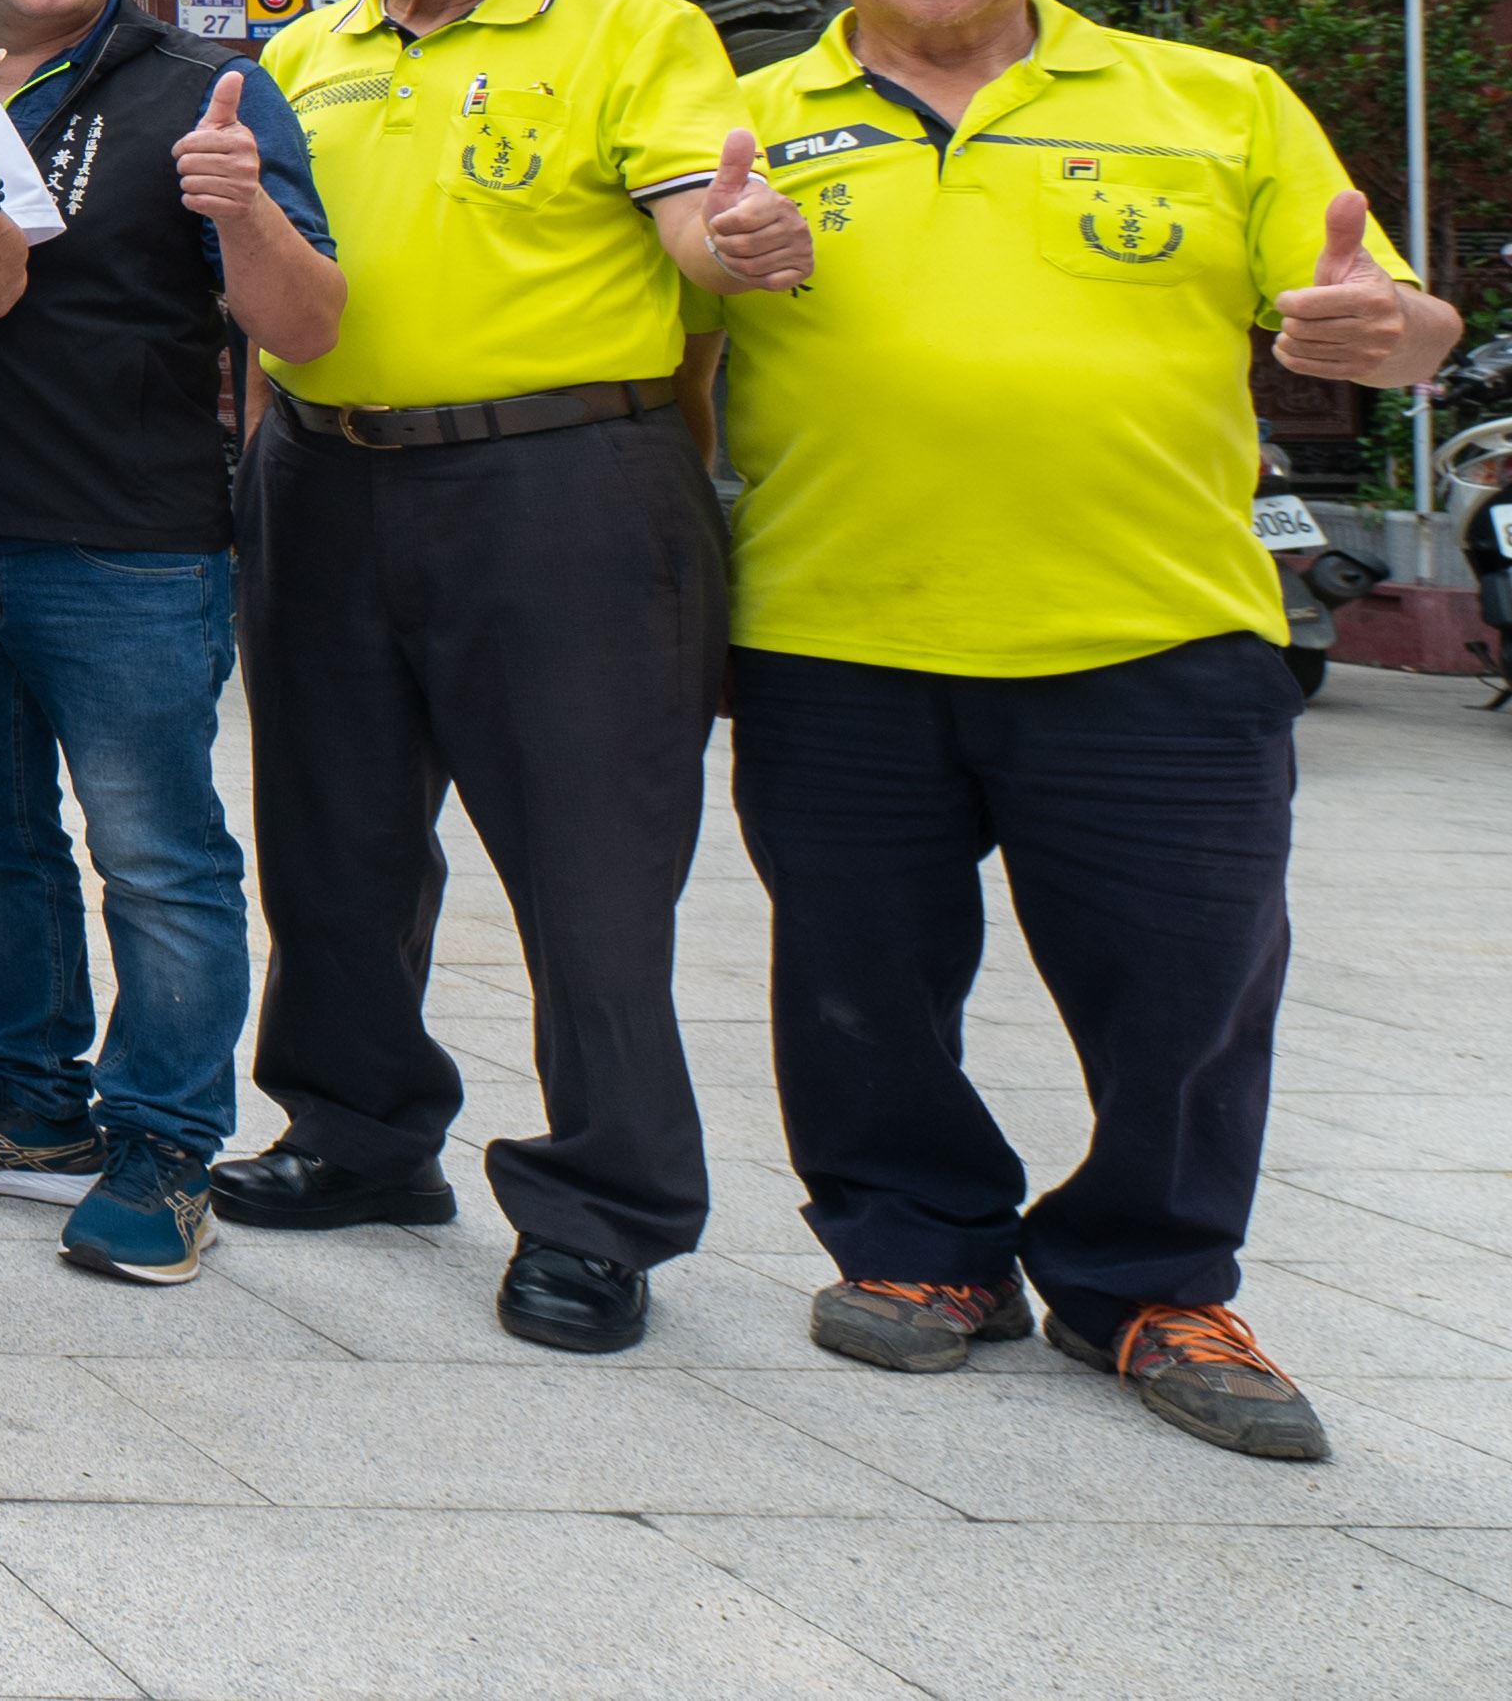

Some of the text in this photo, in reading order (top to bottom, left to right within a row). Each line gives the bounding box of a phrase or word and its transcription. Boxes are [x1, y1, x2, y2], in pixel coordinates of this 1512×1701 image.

[203, 14, 231, 34] 27
[64, 113, 105, 216] 大溪區里長聯誼會
[488, 135, 516, 180] 永昌宮
[785, 129, 860, 162] FILA
[818, 182, 854, 234] 總務
[1115, 202, 1149, 250] 永昌宮
